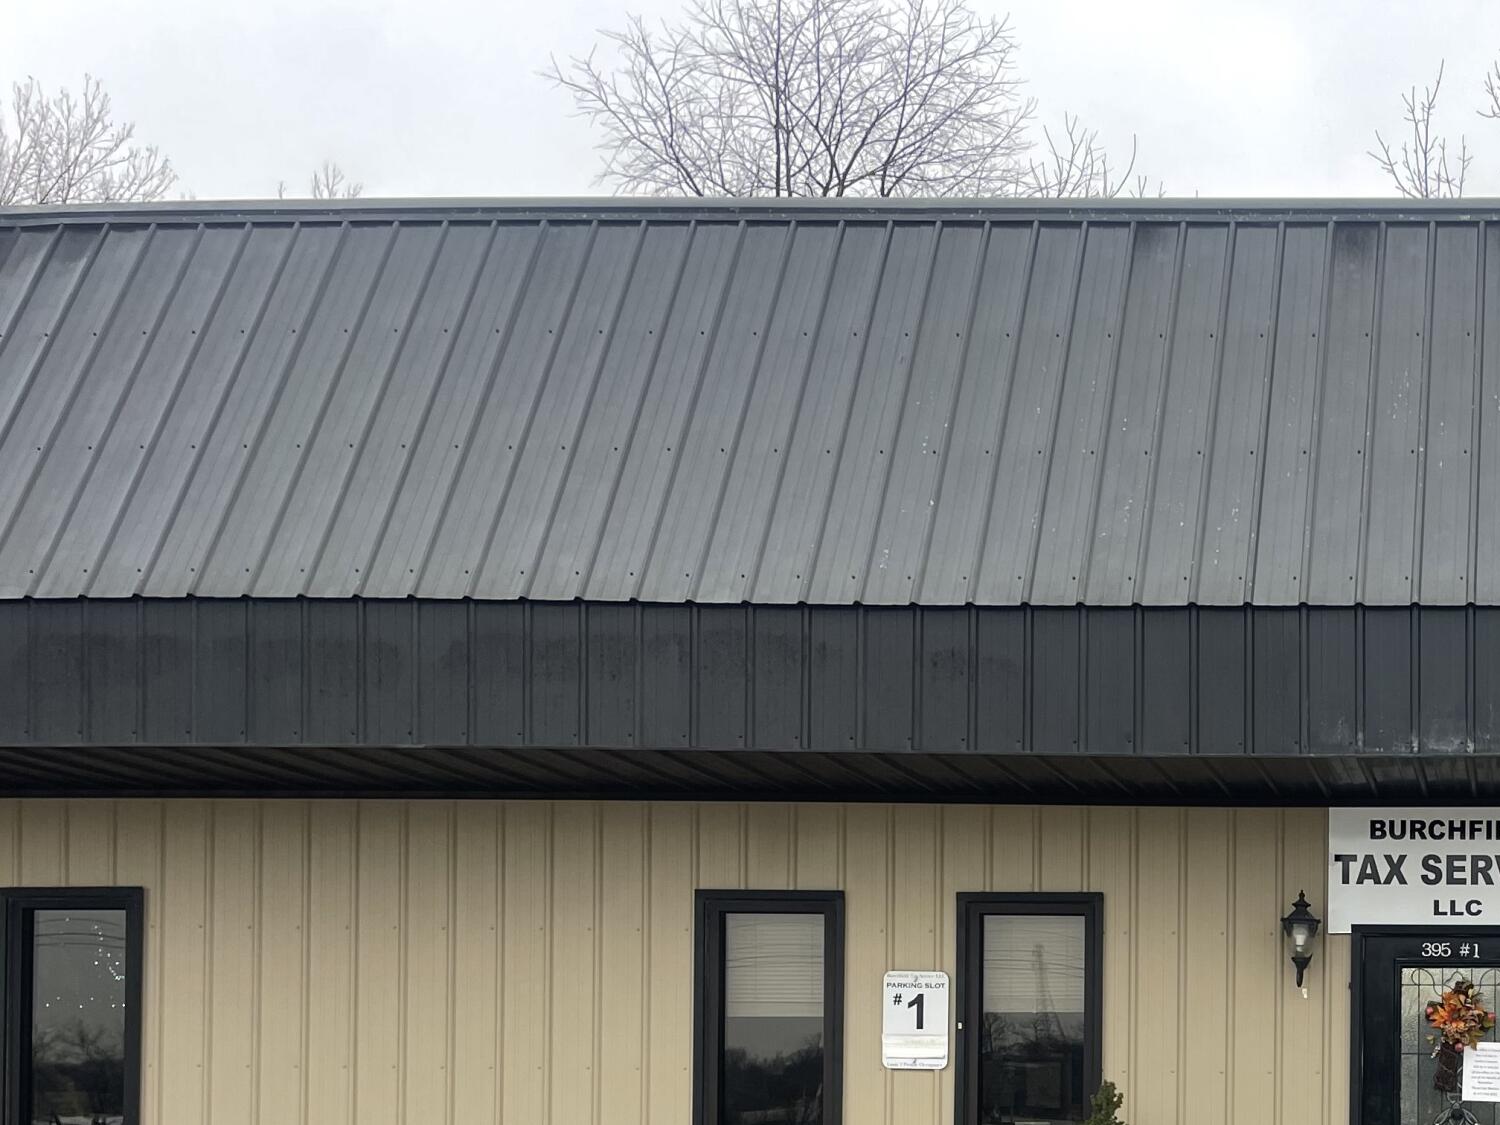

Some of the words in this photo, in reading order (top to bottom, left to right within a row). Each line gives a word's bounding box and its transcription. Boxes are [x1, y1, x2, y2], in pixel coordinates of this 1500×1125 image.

[1334, 854, 1408, 885] TAX
[1433, 899, 1483, 916] LLC
[1421, 942, 1452, 958] 395
[1459, 942, 1480, 959] #1
